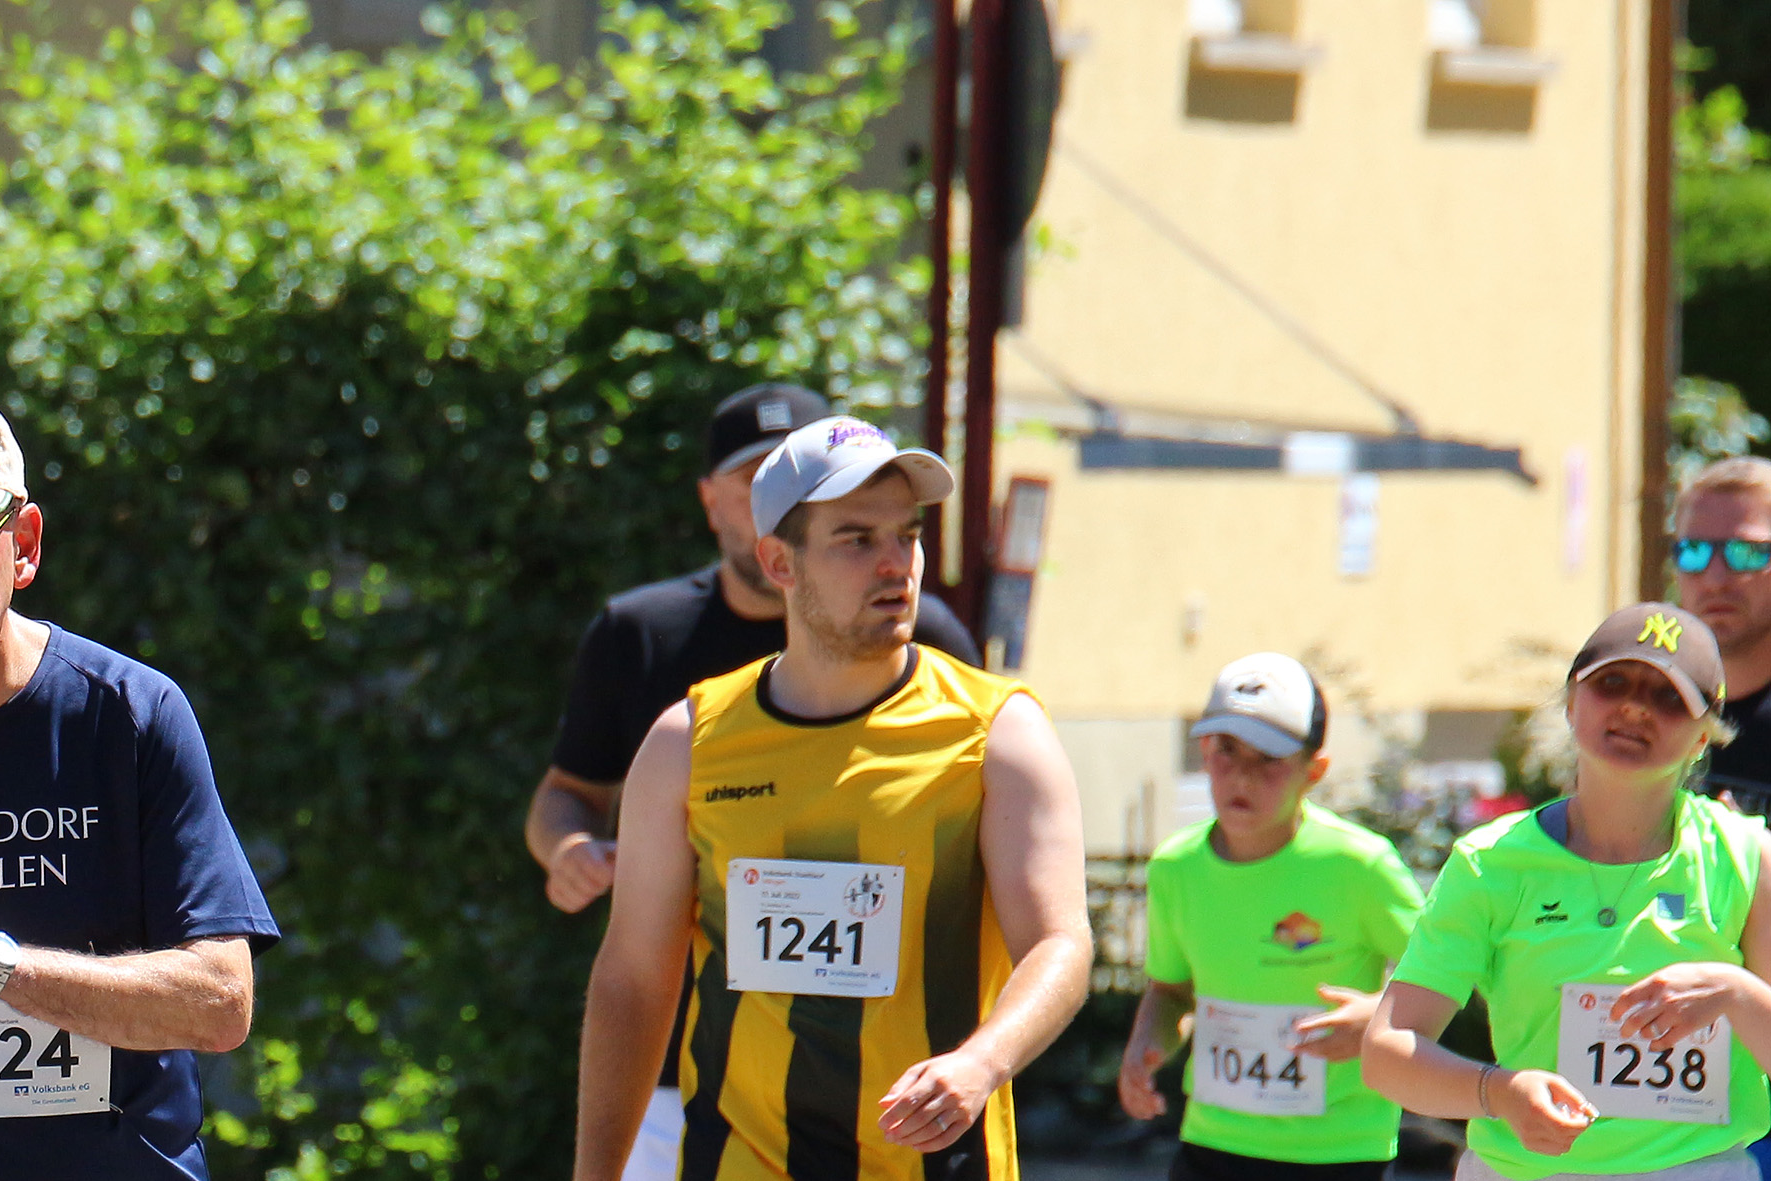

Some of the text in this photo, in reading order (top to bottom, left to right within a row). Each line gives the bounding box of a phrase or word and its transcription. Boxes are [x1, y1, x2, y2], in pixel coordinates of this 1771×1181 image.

[706, 781, 775, 802] uhlsport
[755, 916, 865, 966] 1241
[32, 1082, 90, 1094] Volksbank eG
[1210, 1044, 1308, 1090] 1044
[1586, 1042, 1707, 1094] 1238
